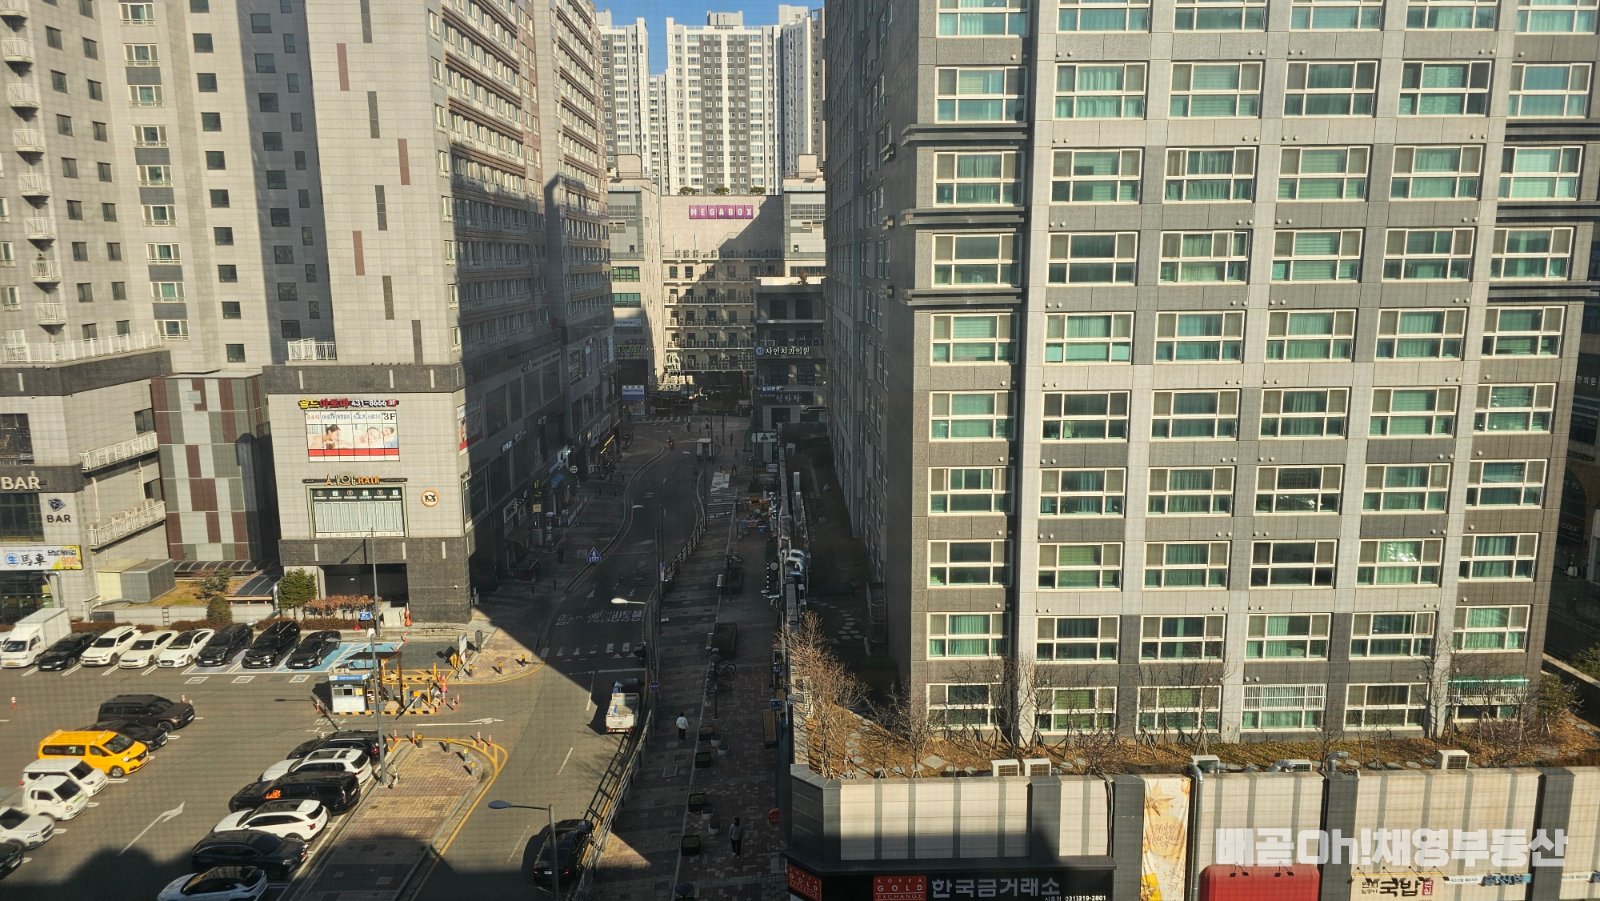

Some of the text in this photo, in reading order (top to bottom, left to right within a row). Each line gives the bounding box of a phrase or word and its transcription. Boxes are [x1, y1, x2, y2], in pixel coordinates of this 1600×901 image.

[690, 208, 751, 216] MEGABOX
[384, 412, 396, 421] 3F
[0, 476, 41, 490] BAR
[46, 514, 72, 523] BAR
[877, 884, 923, 892] GOLD
[931, 878, 1060, 898] 한국금거래소
[1379, 879, 1421, 897] 국밥
